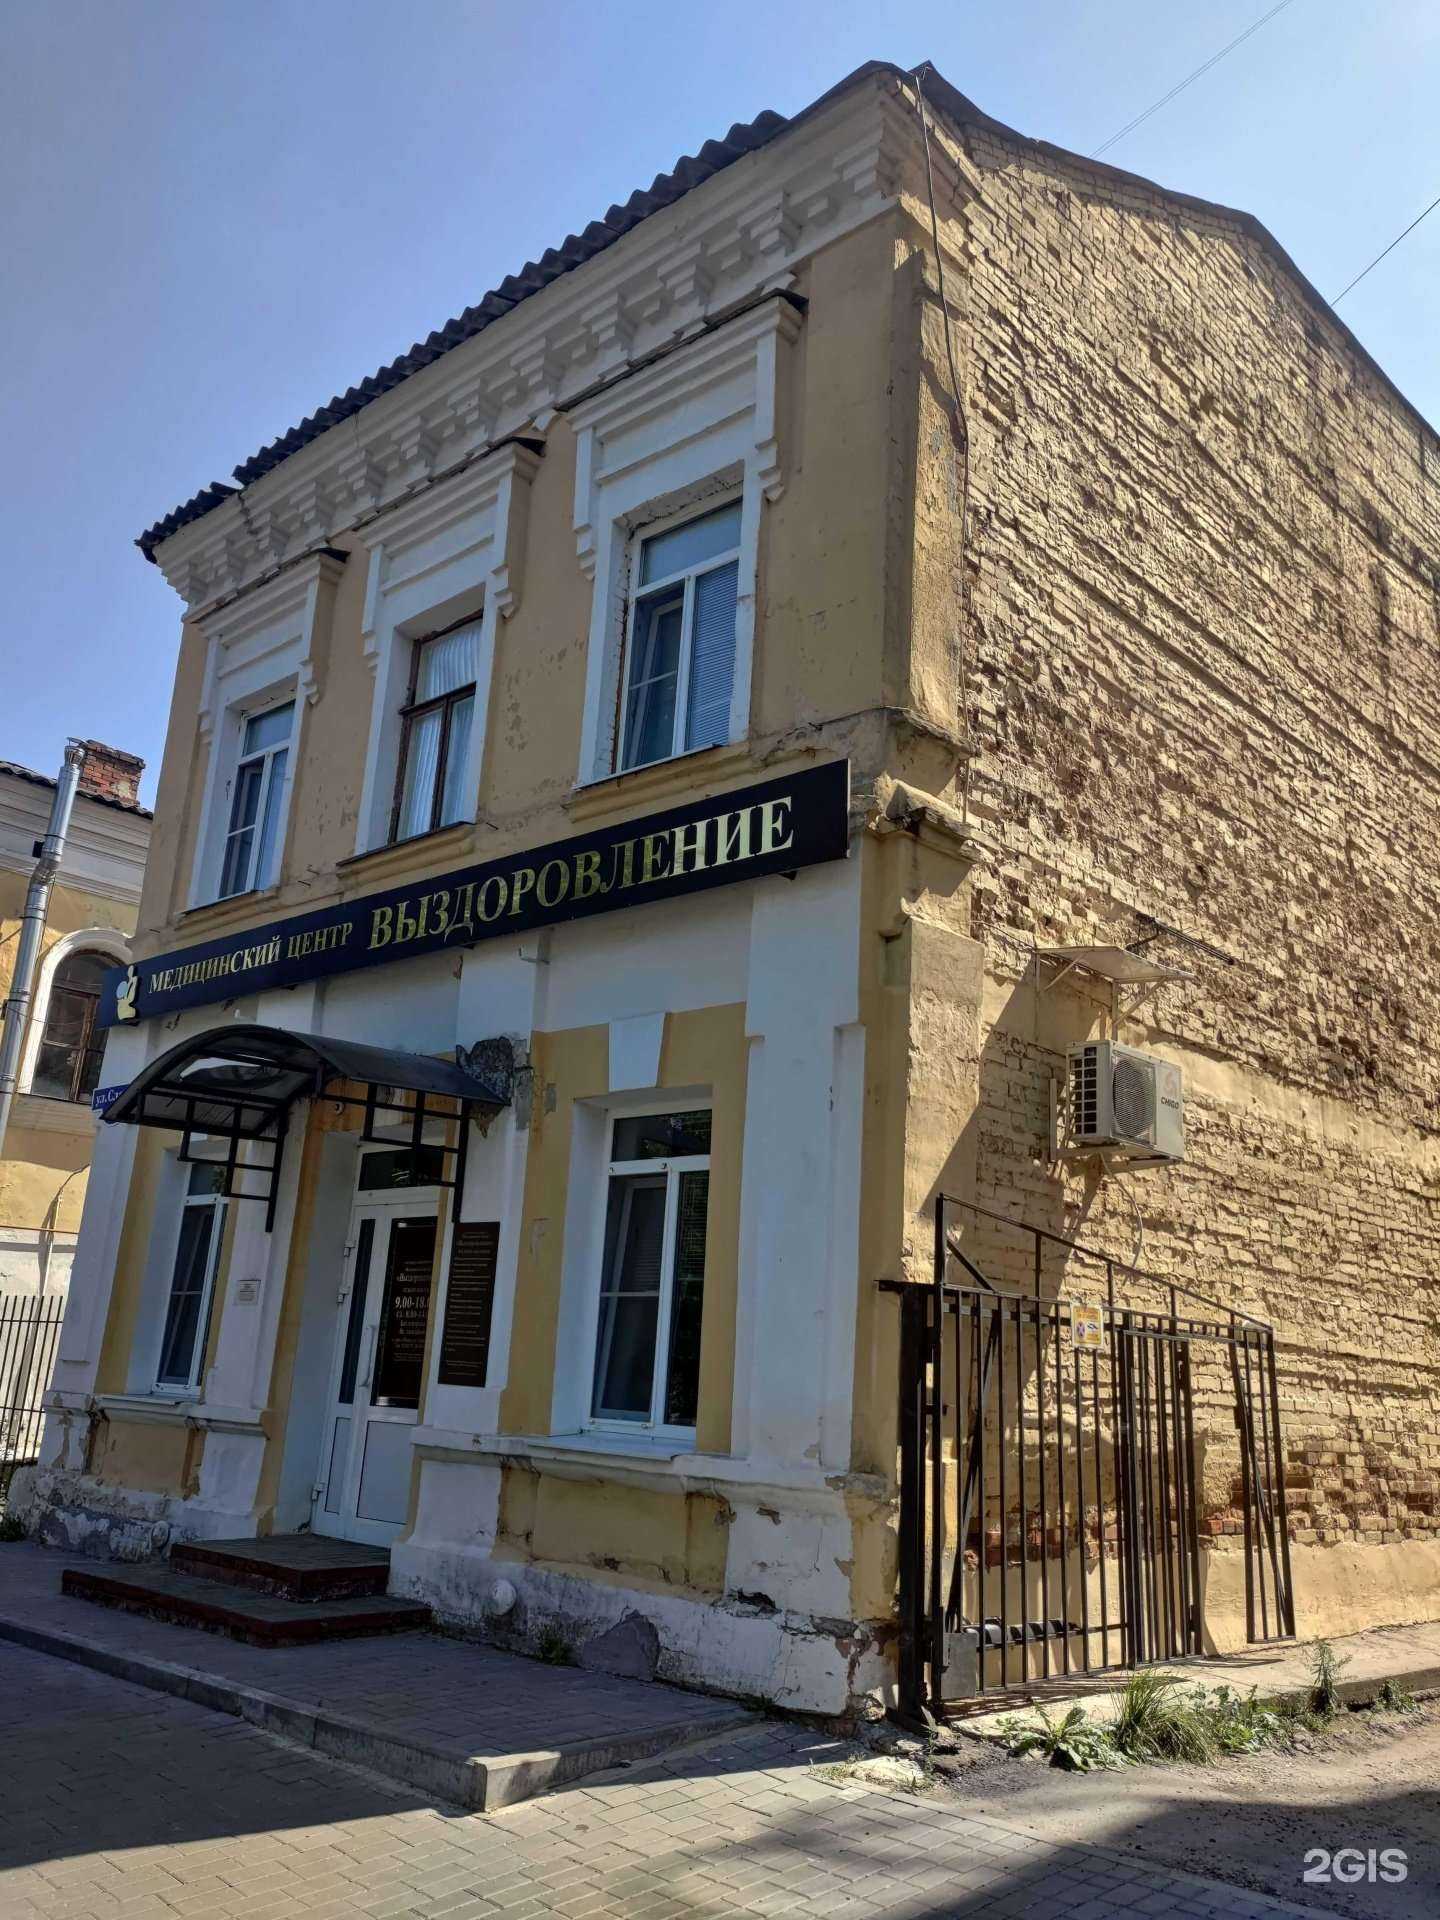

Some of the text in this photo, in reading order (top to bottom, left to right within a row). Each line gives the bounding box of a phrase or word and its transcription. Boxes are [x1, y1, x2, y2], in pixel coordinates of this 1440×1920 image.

[148, 796, 795, 993] МЕДИЦИНСКИЙ ЦЕНТР ВЫЗДОРОВЛЕНИЕ
[95, 1094, 107, 1107] ул.
